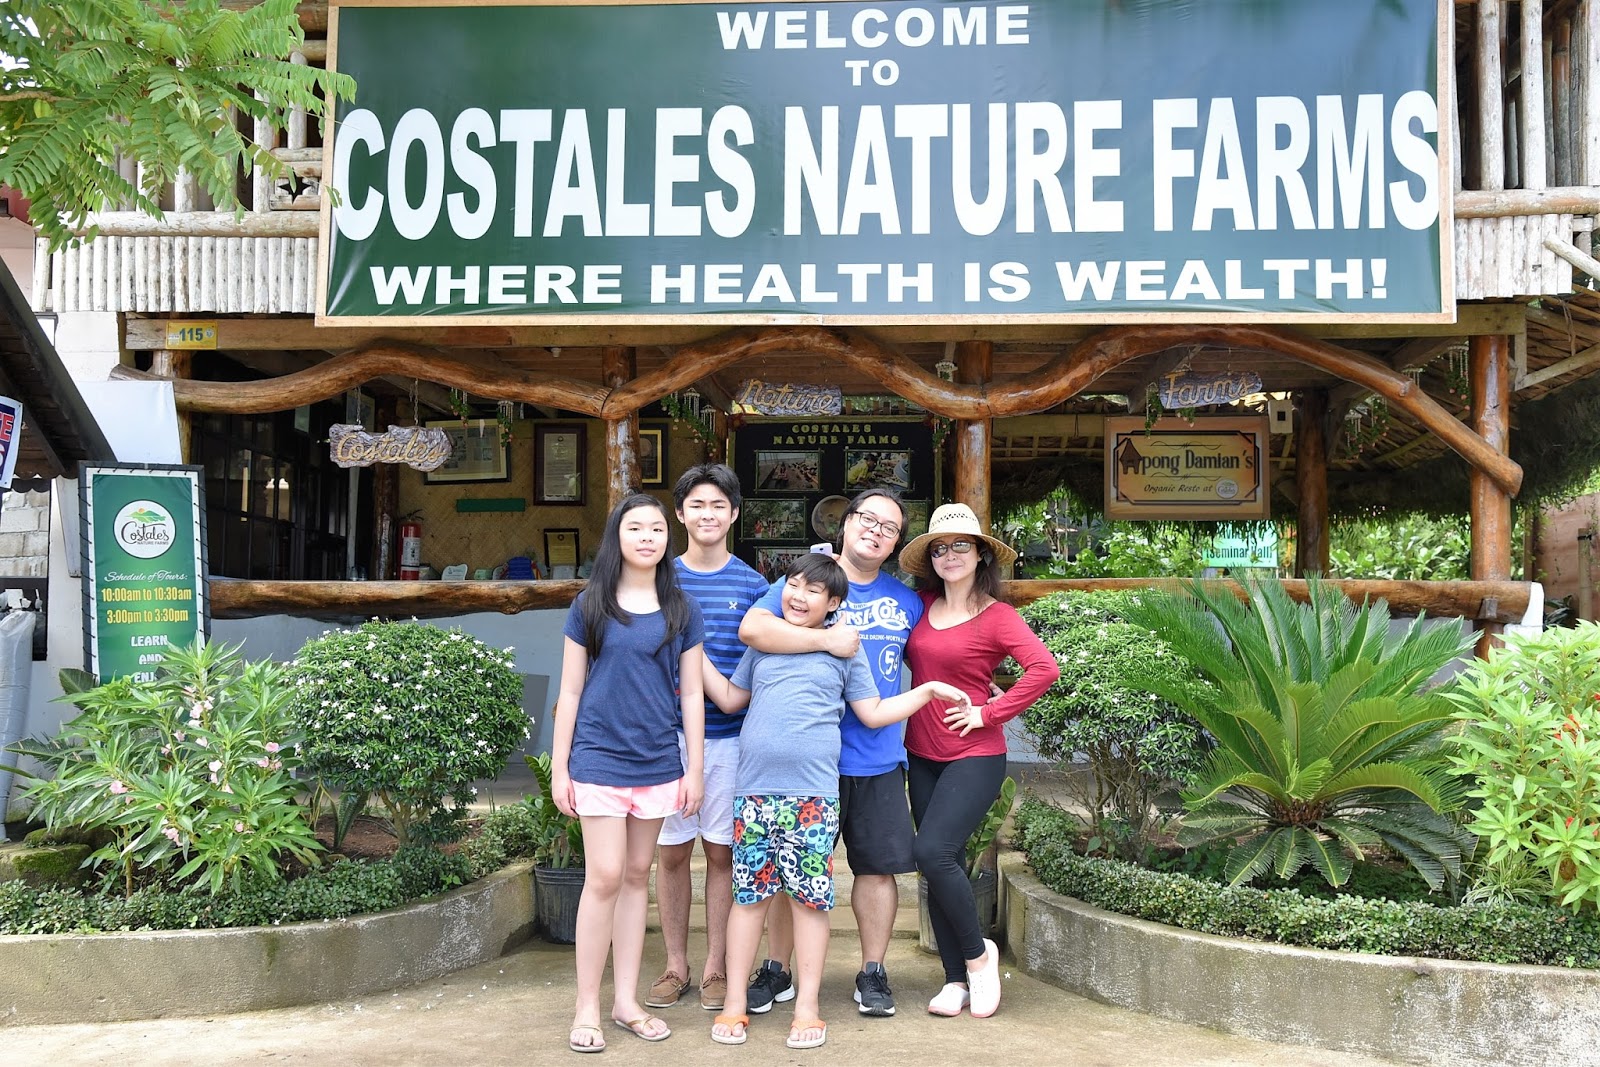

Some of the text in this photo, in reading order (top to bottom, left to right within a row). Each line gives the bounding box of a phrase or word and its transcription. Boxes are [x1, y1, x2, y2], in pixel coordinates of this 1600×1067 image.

[716, 6, 1030, 50] WELCOME
[844, 60, 900, 86] TO
[333, 90, 1440, 240] COSTALES NATURE FARMS
[369, 258, 1387, 305] WHERE HEALTH IS WEALTH!
[180, 328, 203, 341] 115
[738, 378, 835, 415] Nature
[1164, 372, 1255, 409] Farms
[791, 424, 872, 433] COSTALES
[336, 430, 447, 463] Costales
[773, 435, 900, 445] NATURE FARMS
[1144, 484, 1175, 493] Organic
[1203, 484, 1213, 492] at
[121, 521, 169, 544] Costales
[104, 570, 188, 582] Schedule of Tours:
[102, 587, 192, 602] 10:00am to 10:30am
[107, 608, 189, 624] 3:00pm to 3:30pm
[130, 635, 168, 647] LEARN
[139, 653, 163, 665] AND
